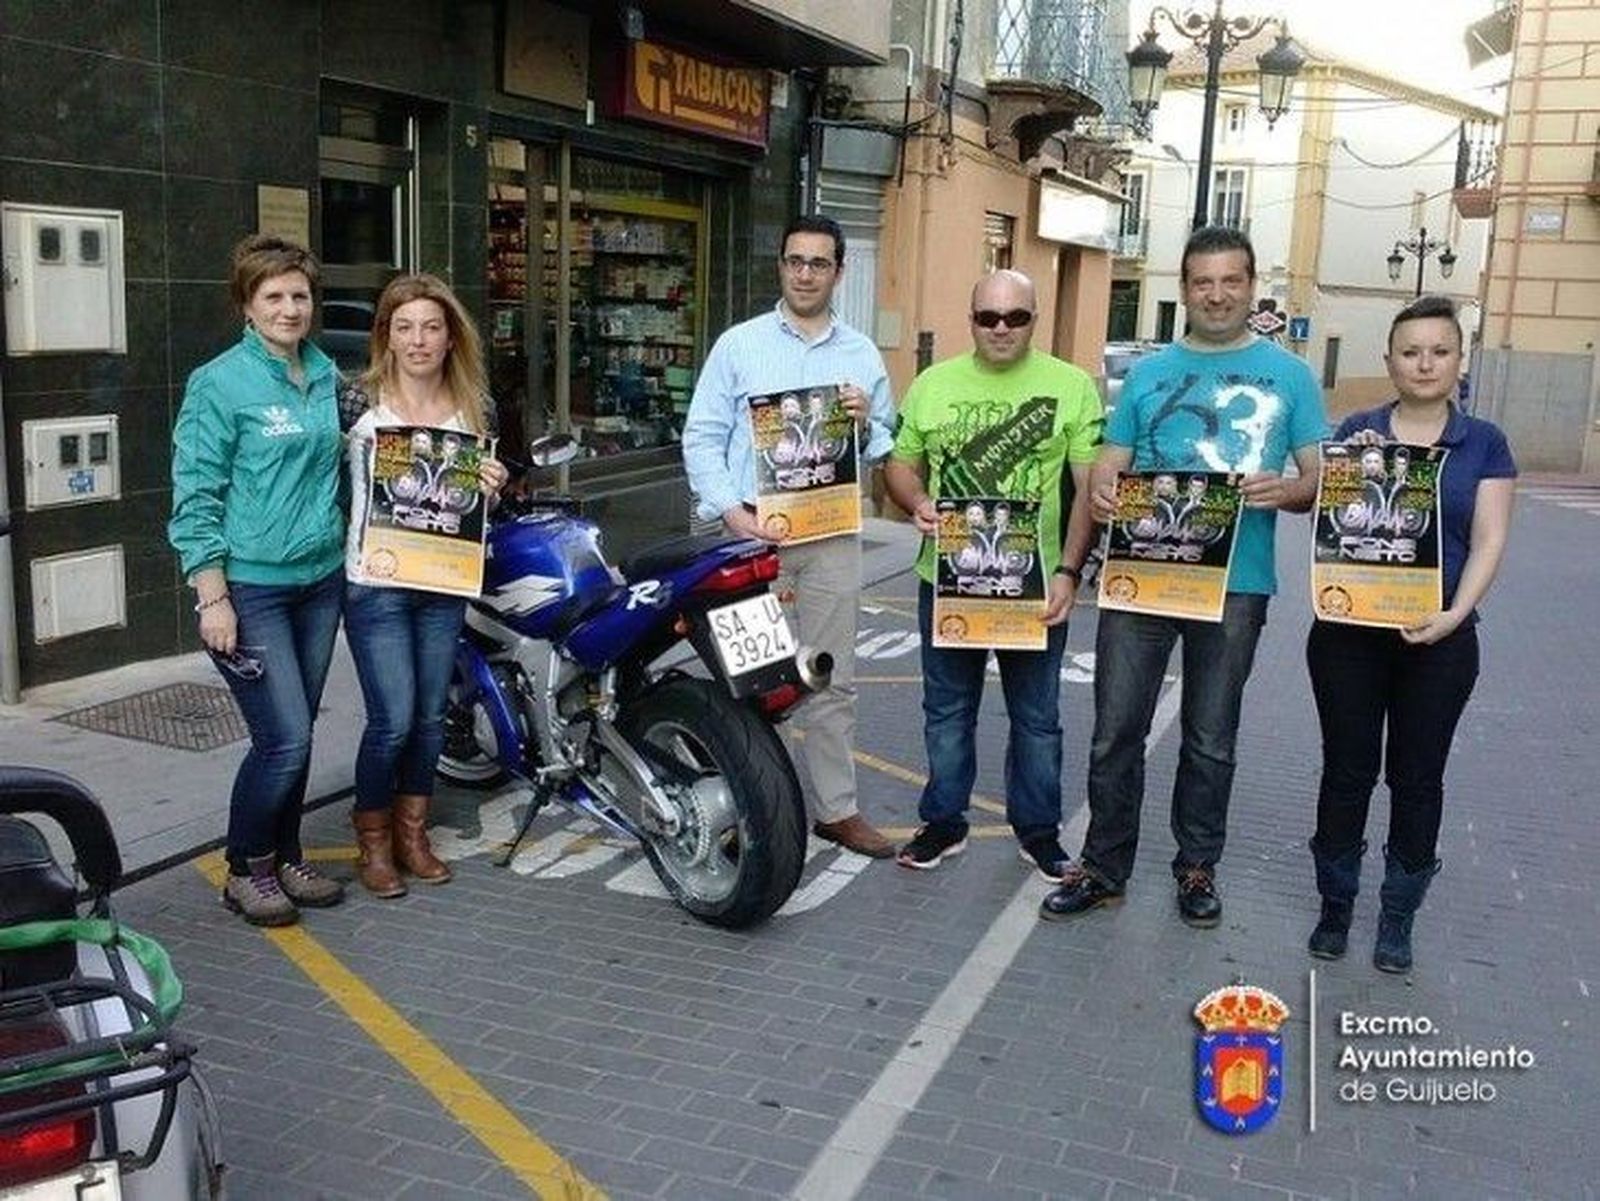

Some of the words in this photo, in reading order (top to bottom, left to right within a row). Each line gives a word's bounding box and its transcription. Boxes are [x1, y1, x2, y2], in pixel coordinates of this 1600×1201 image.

[673, 54, 763, 118] TABACOS
[466, 125, 477, 148] 5
[729, 628, 787, 669] 3924
